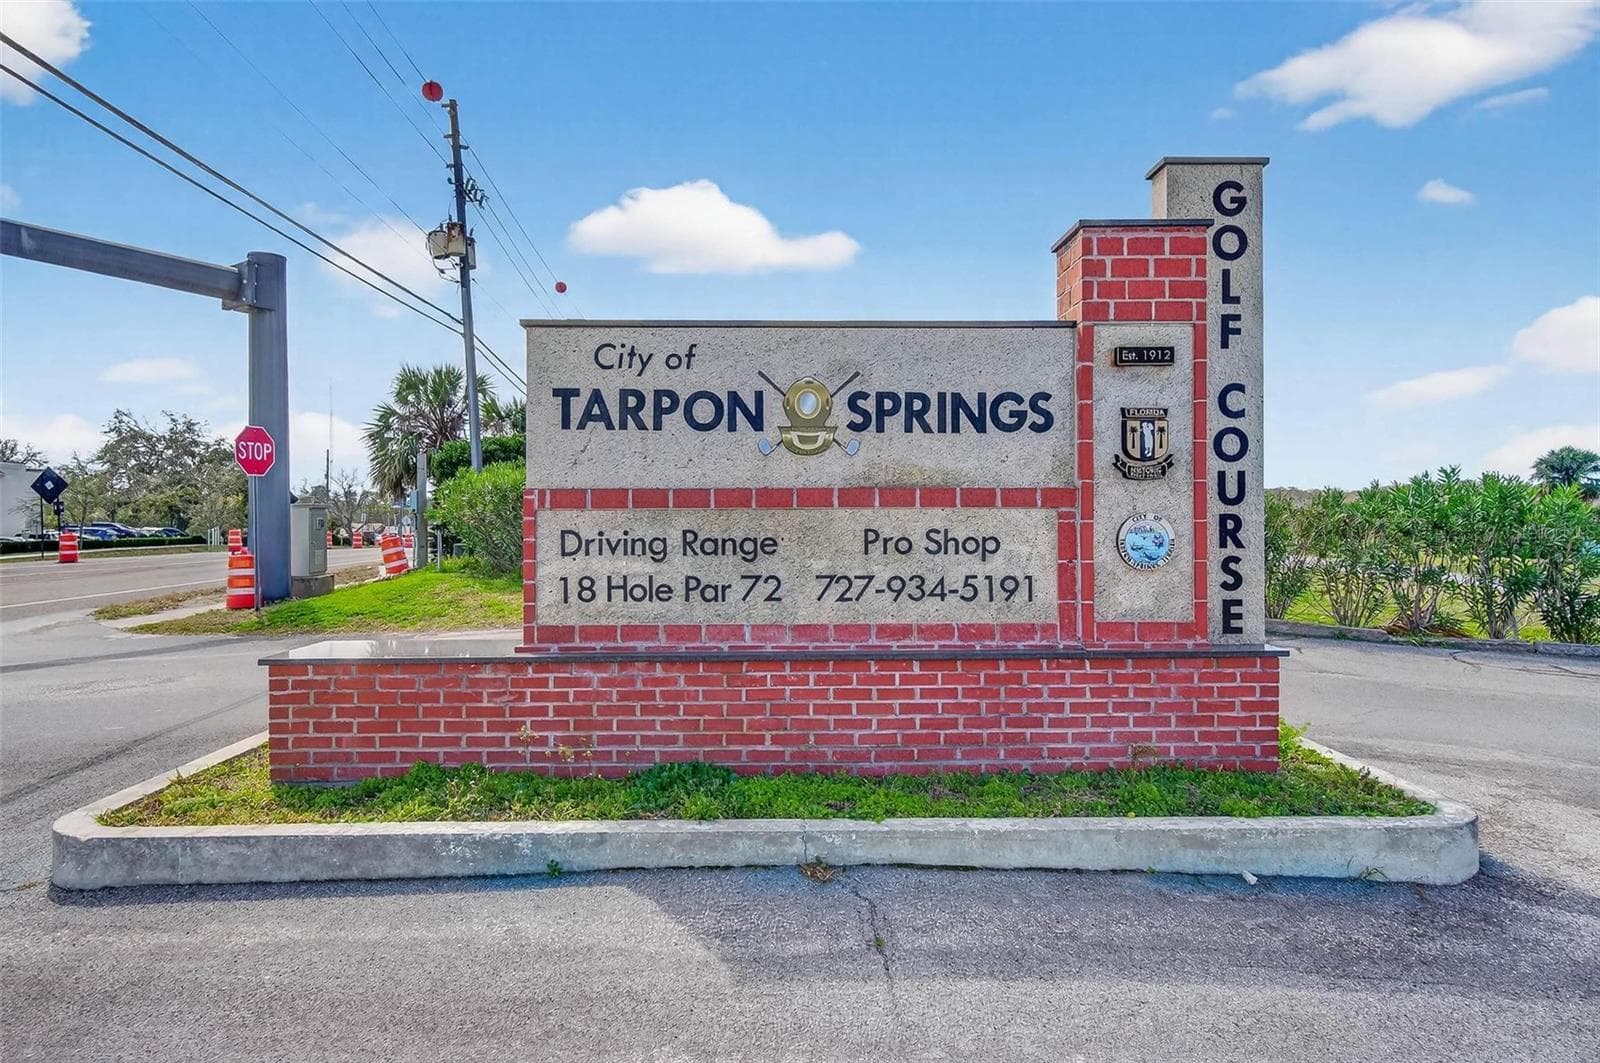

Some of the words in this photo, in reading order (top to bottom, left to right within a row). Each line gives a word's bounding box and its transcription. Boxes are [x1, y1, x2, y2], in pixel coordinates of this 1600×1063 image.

[1212, 180, 1248, 349] GOLF
[593, 343, 653, 376] City
[665, 344, 697, 370] of
[1122, 350, 1138, 361] Est.
[1143, 350, 1171, 360] 1912
[552, 387, 764, 432] TARPON
[846, 390, 1054, 433] SPRINGS
[238, 441, 272, 460] STOP
[1213, 382, 1249, 634] COURSE
[560, 529, 668, 563] Driving
[682, 529, 778, 563] Range
[864, 528, 913, 555] Pro
[924, 528, 1001, 562] Shop
[559, 575, 597, 604] 18
[606, 575, 674, 603] Hole
[684, 575, 732, 603] Par
[740, 574, 783, 602] 72
[815, 574, 1034, 602] 727-934-5191
